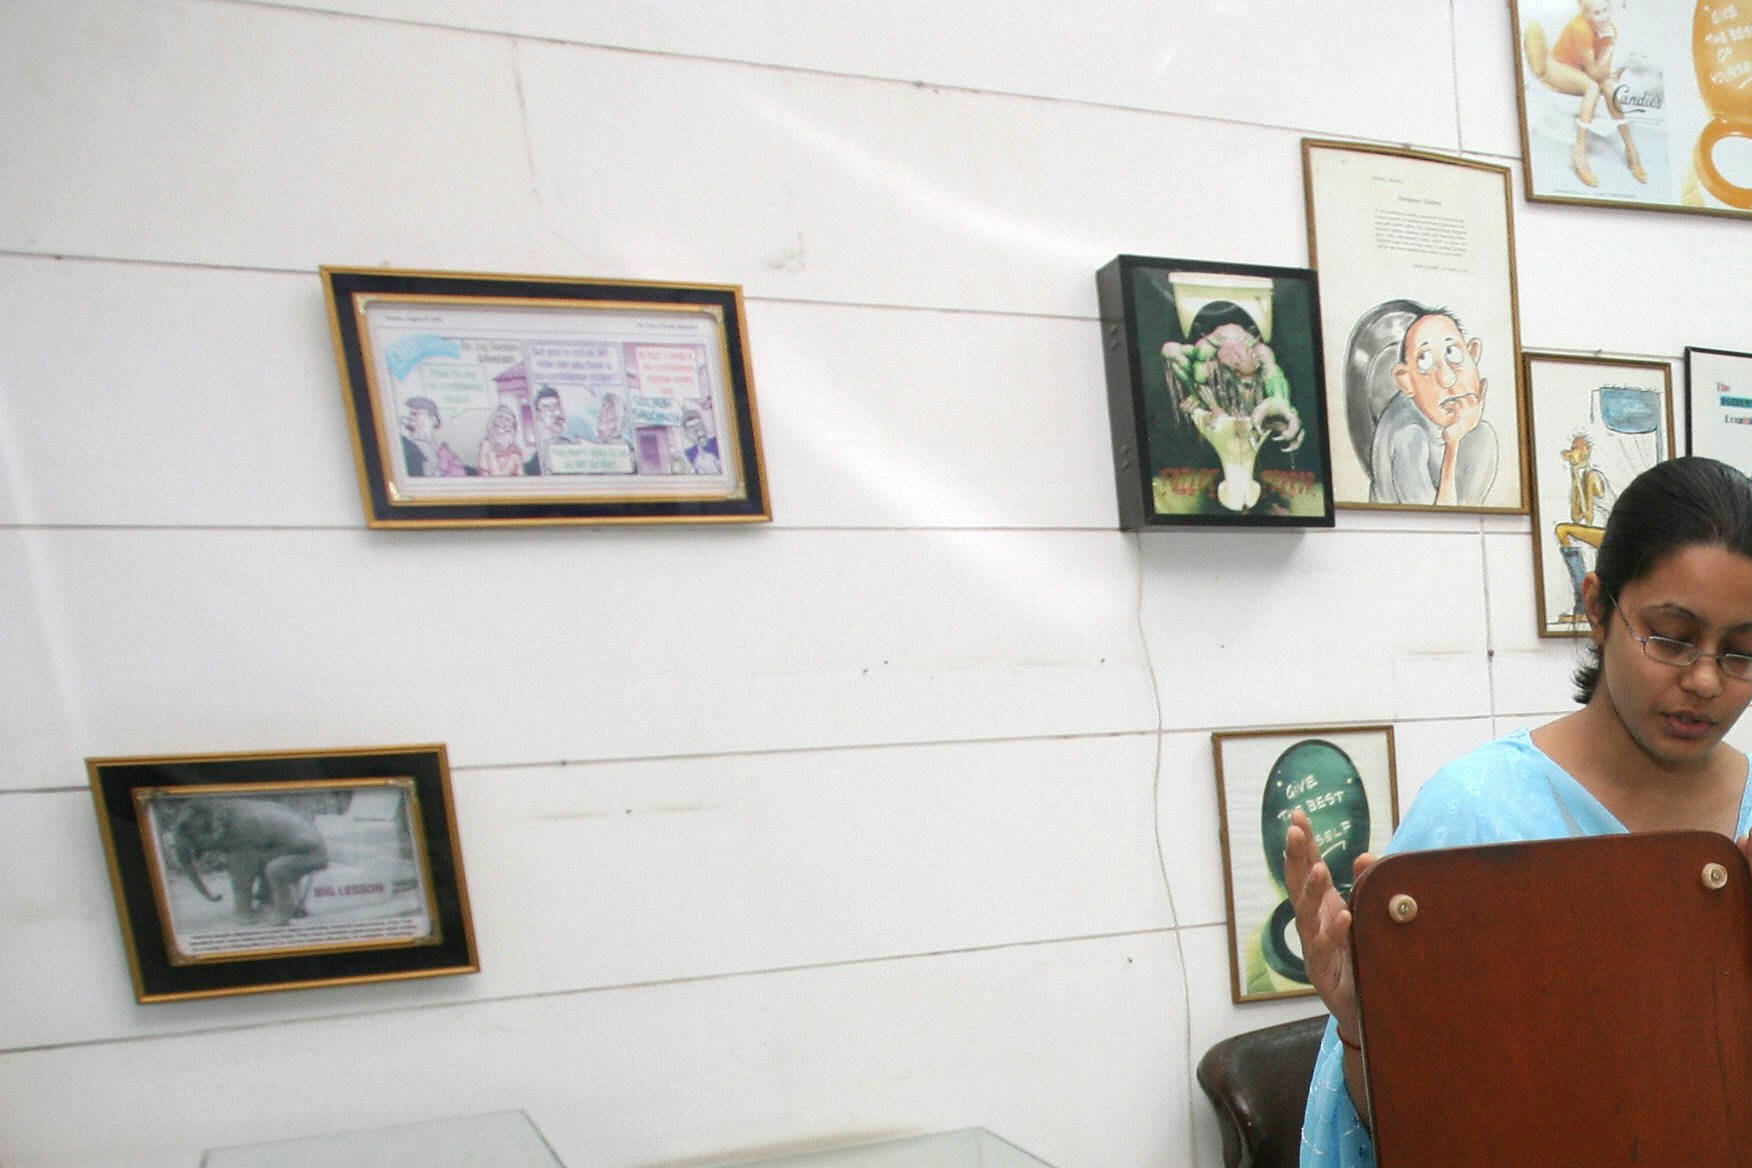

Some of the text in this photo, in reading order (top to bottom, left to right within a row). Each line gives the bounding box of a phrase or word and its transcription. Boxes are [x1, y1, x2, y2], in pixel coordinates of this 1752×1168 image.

[1286, 774, 1319, 799] GIVE
[1305, 790, 1345, 813] BEST
[337, 883, 385, 896] LESSON
